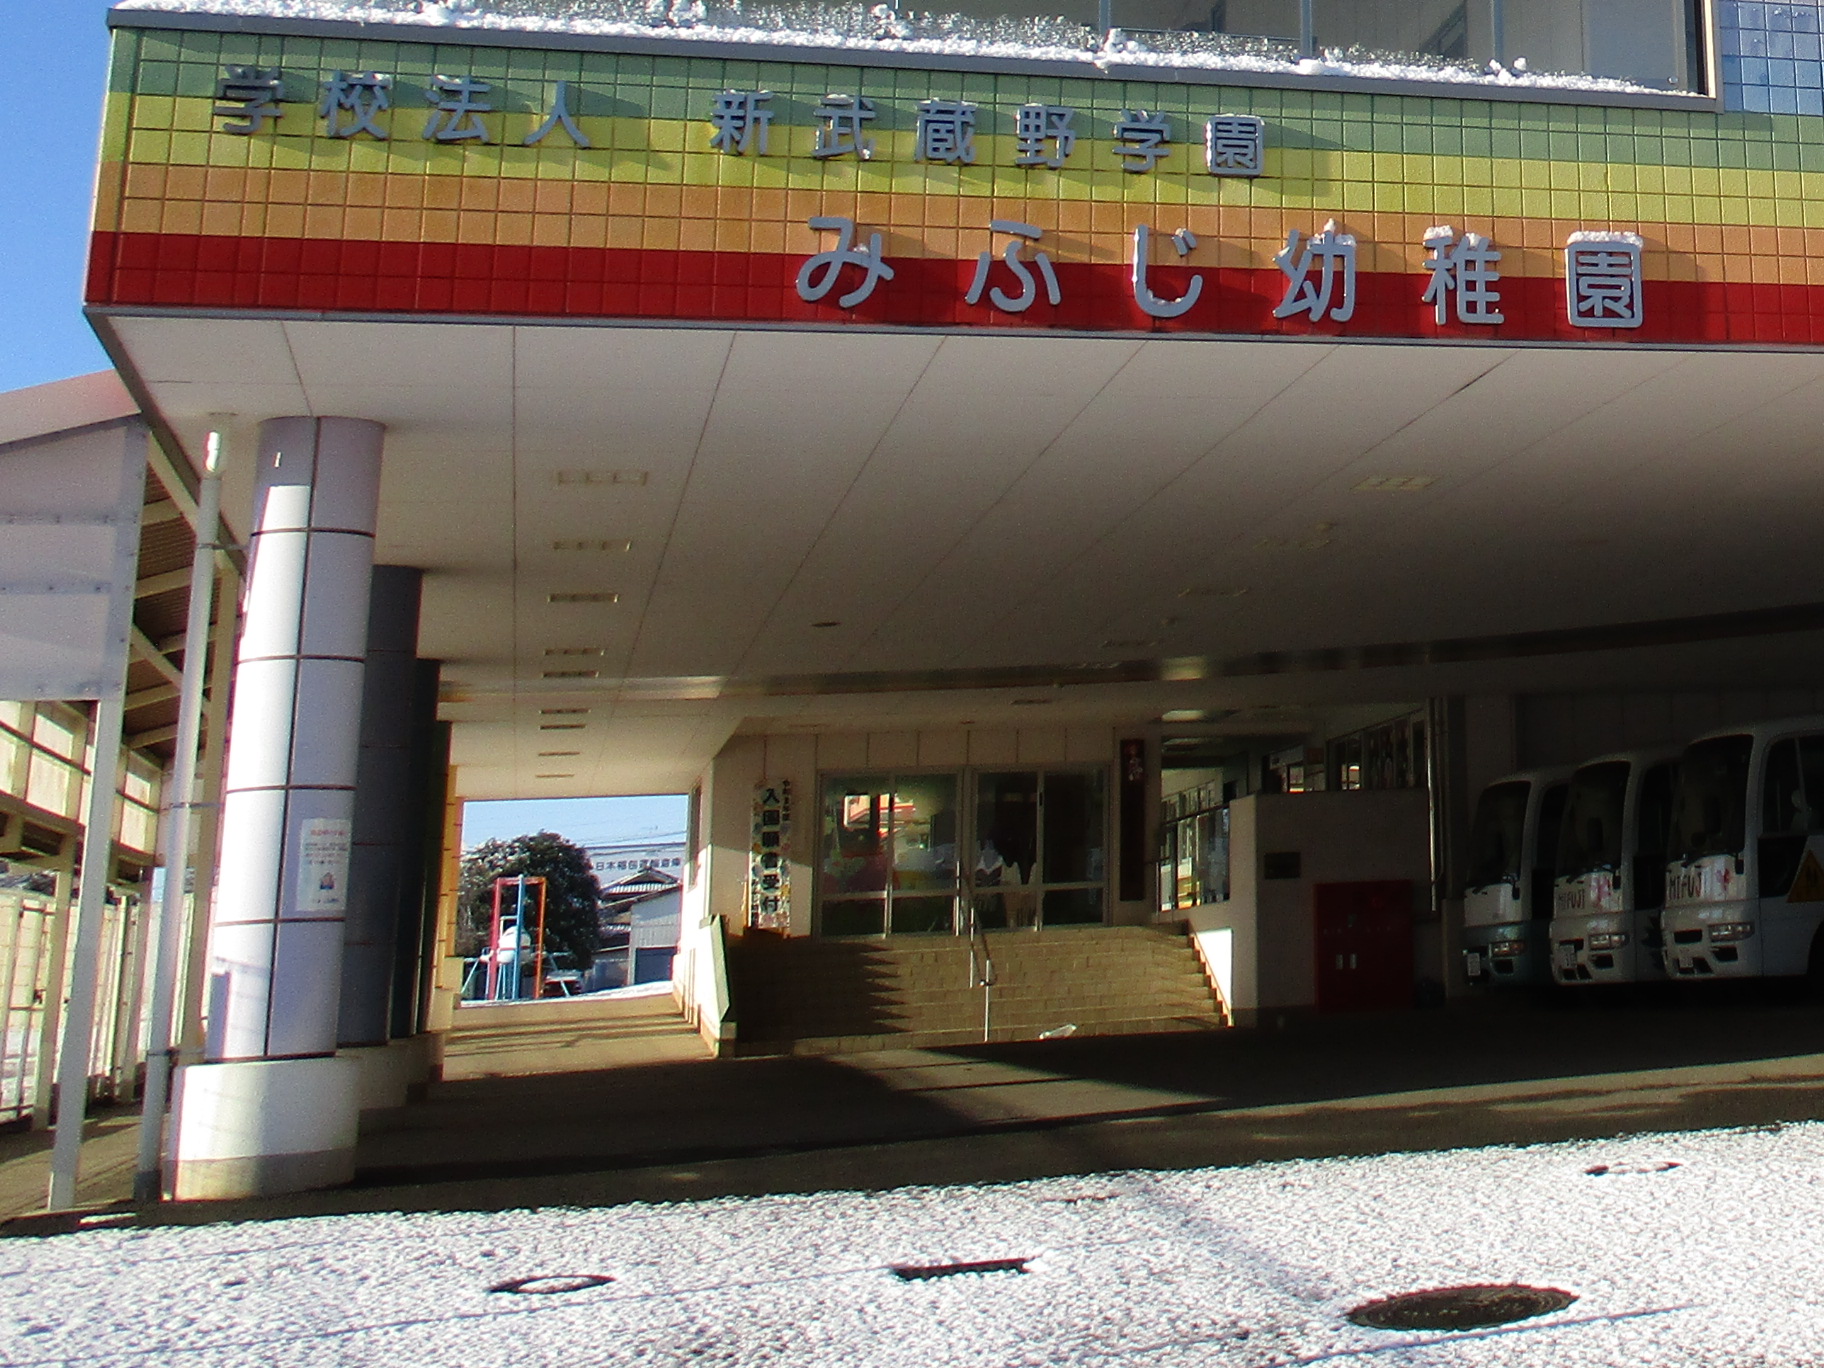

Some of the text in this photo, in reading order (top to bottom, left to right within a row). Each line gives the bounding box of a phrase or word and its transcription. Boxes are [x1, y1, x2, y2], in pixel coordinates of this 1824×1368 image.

[213, 64, 1266, 178] 学校法人 新武蔵野学園
[795, 216, 1644, 329] みふじ幼稚園
